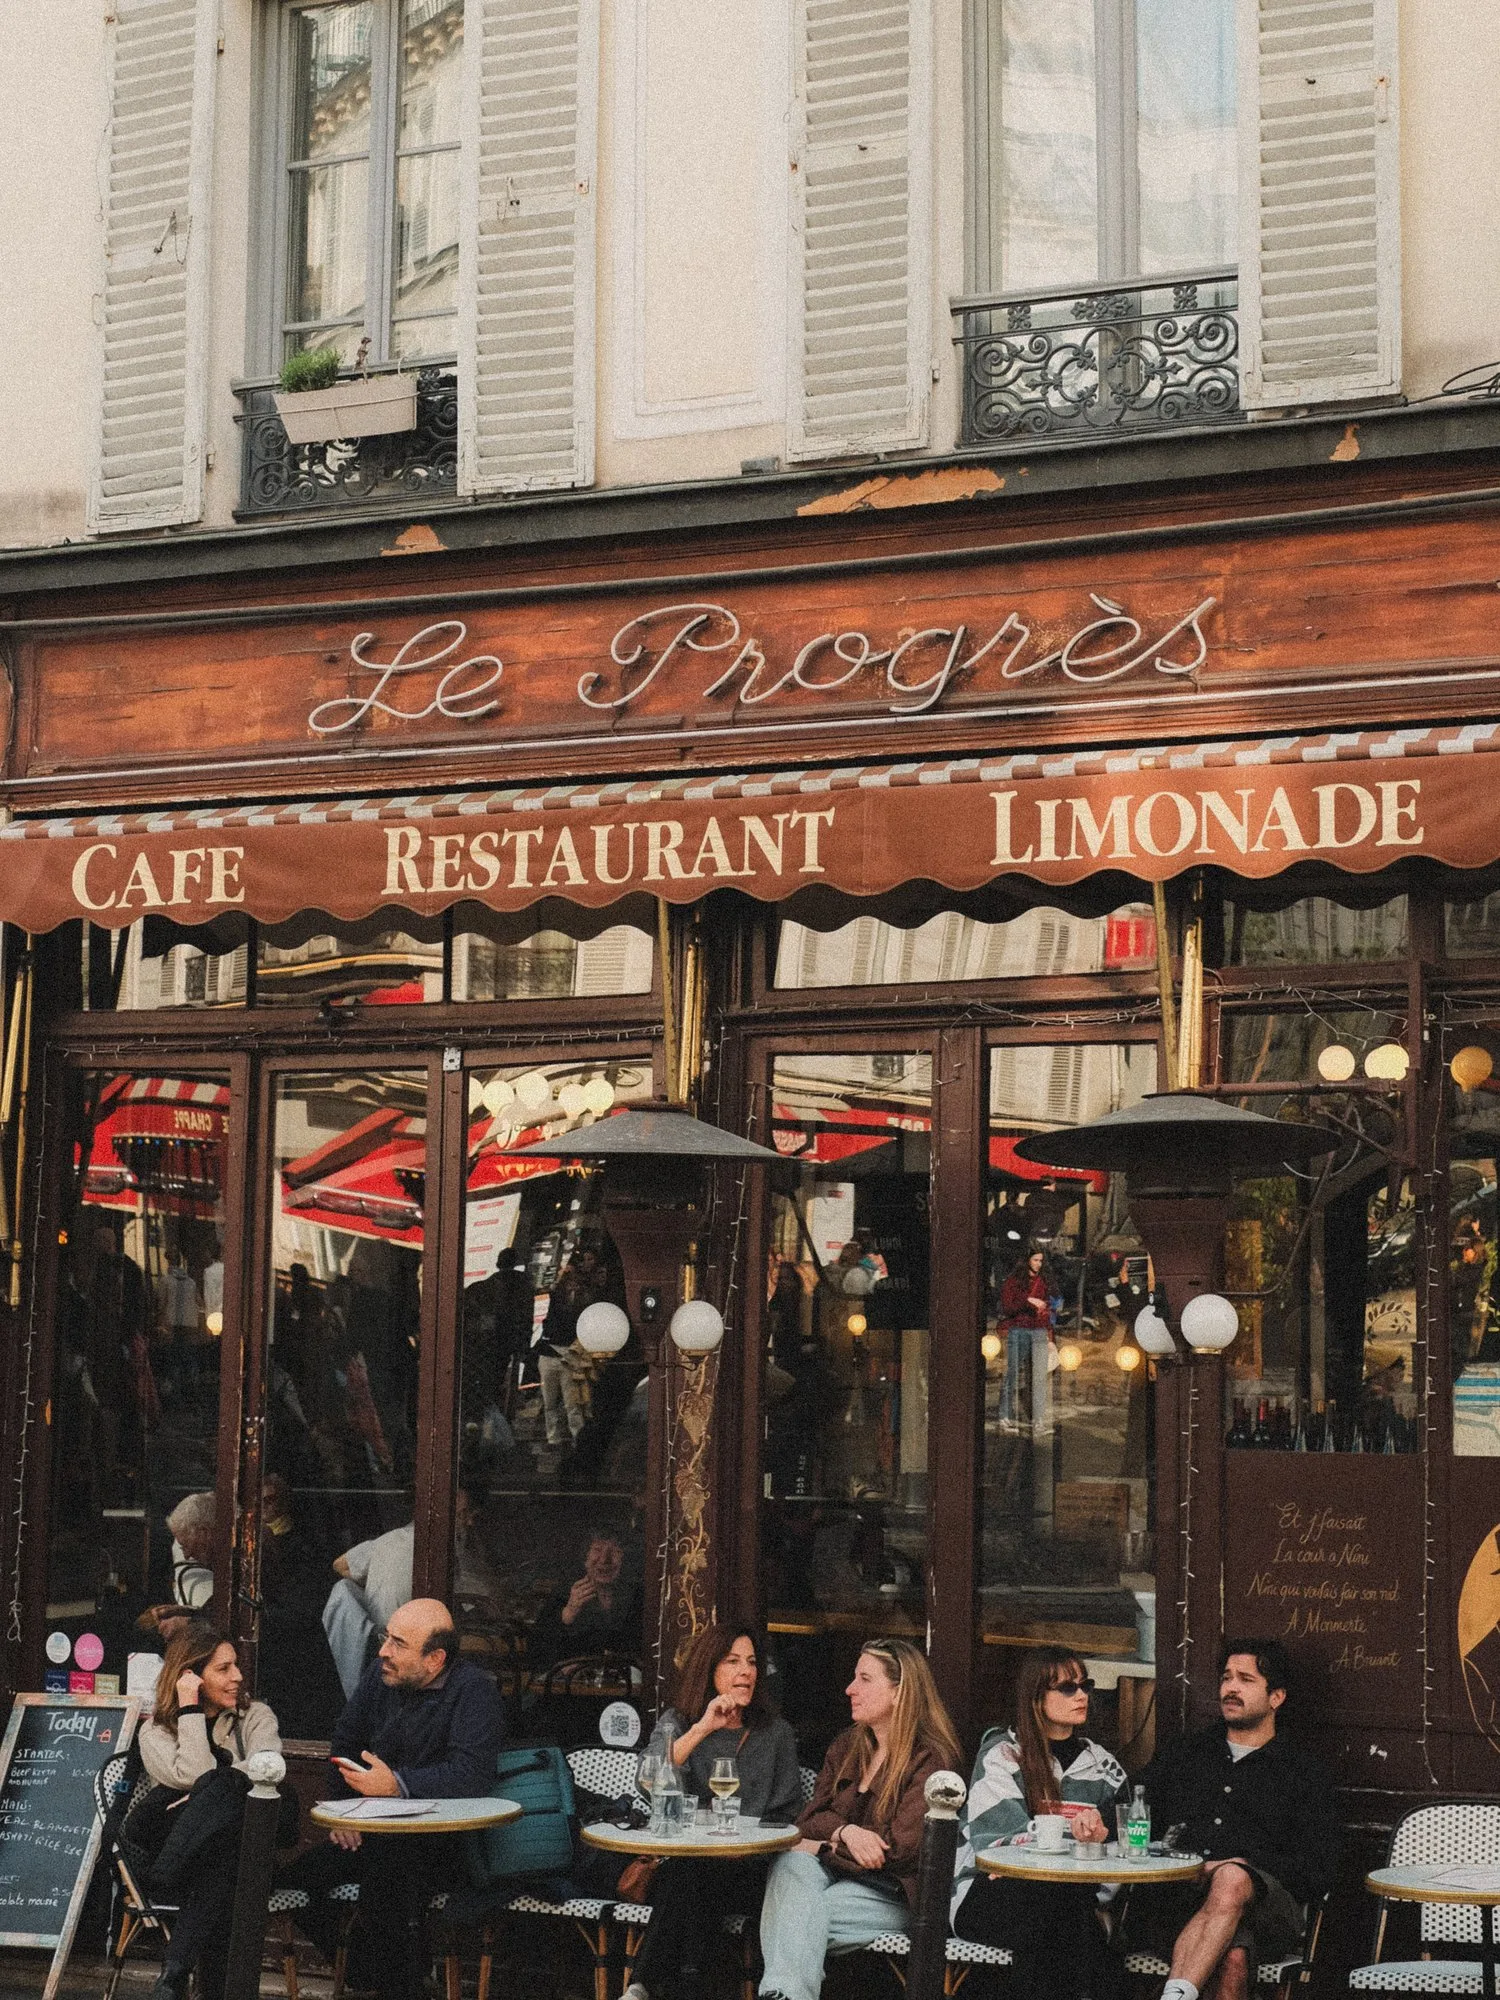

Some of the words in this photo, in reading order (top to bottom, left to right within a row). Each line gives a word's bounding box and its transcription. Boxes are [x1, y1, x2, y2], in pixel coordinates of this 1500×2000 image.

[309, 620, 503, 733] Le
[578, 593, 1217, 713] Progrès
[71, 843, 246, 911] CAFE
[381, 806, 836, 896] RESTAURANT
[990, 780, 1425, 866] LIMONADE
[46, 1710, 98, 1742] Today
[1128, 1824, 1148, 1837] rite
